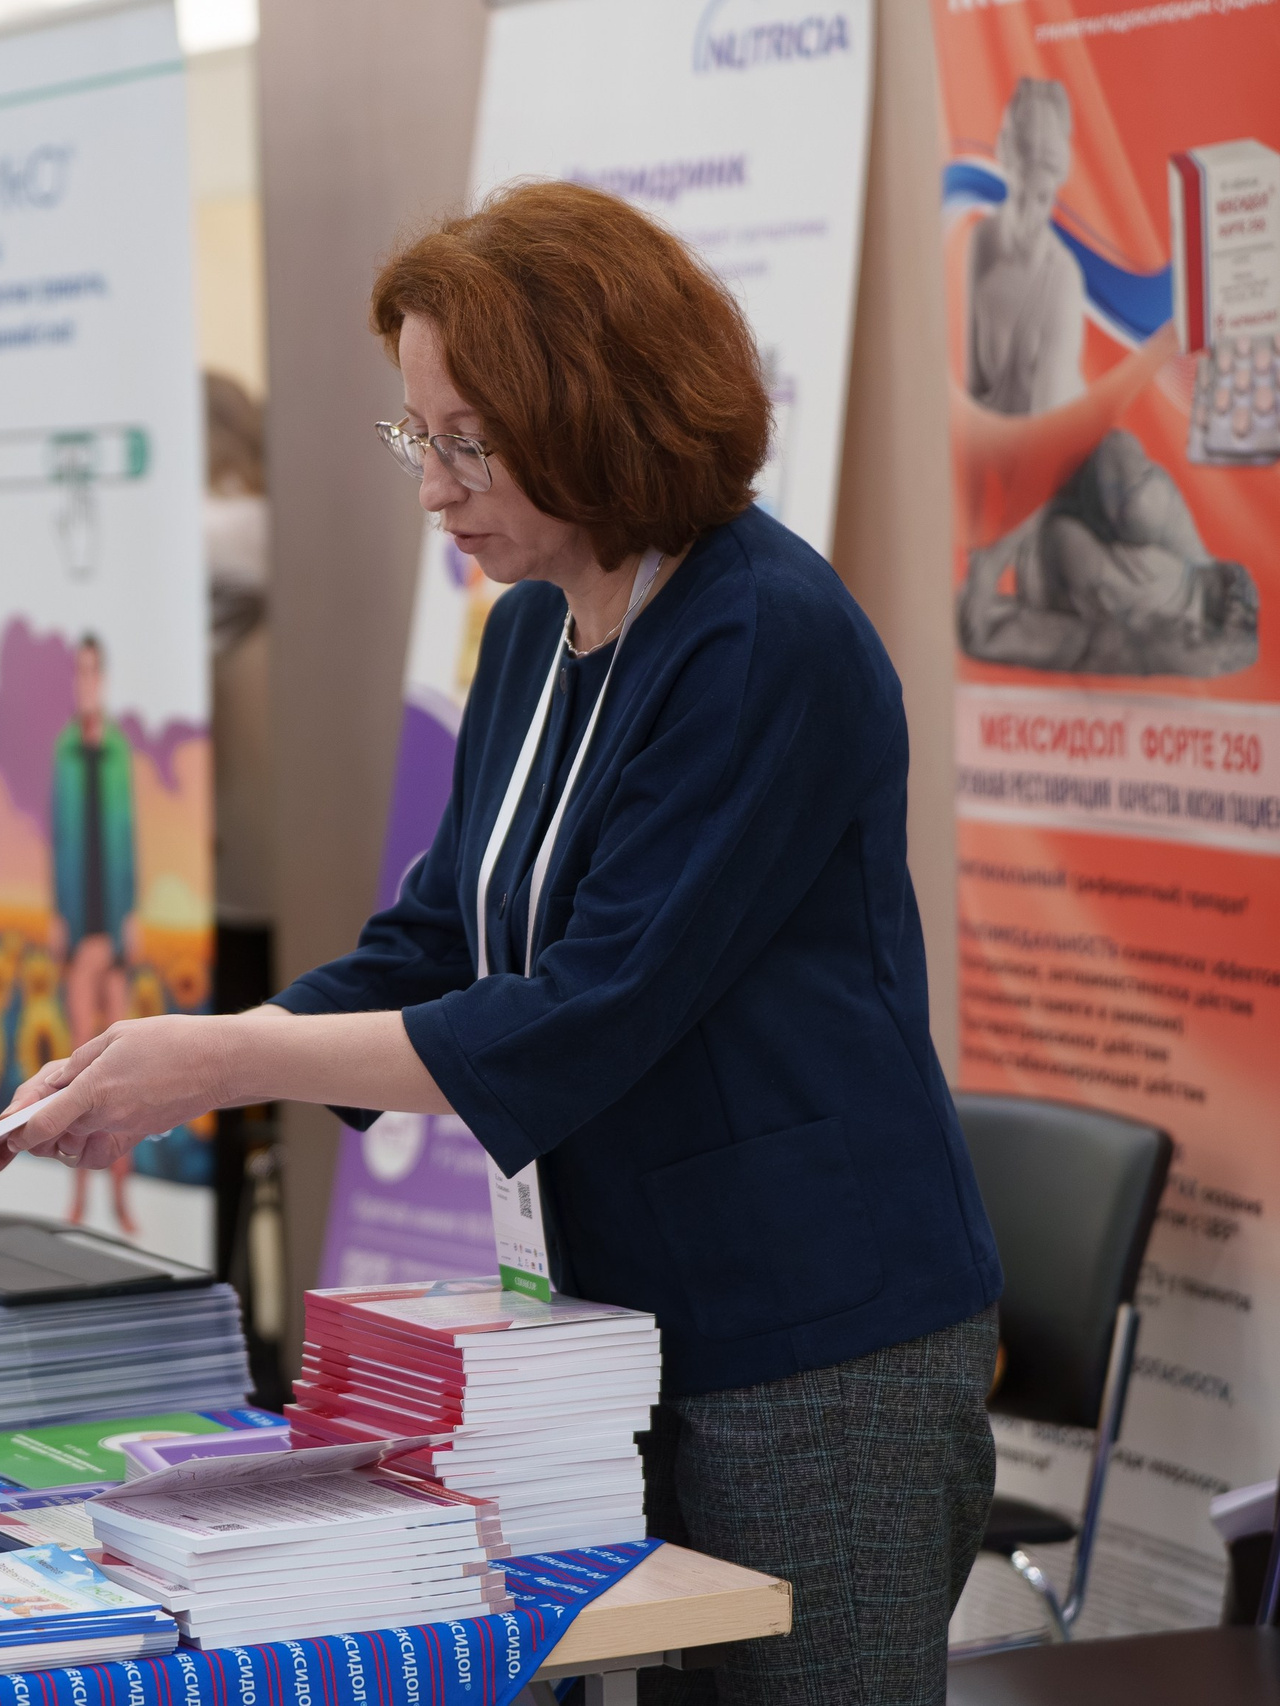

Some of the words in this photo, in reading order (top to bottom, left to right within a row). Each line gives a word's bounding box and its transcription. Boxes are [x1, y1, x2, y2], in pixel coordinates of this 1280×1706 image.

[705, 14, 848, 72] NUTRICIA
[1141, 722, 1215, 771] ФОРТЕ
[1222, 730, 1263, 776] 250
